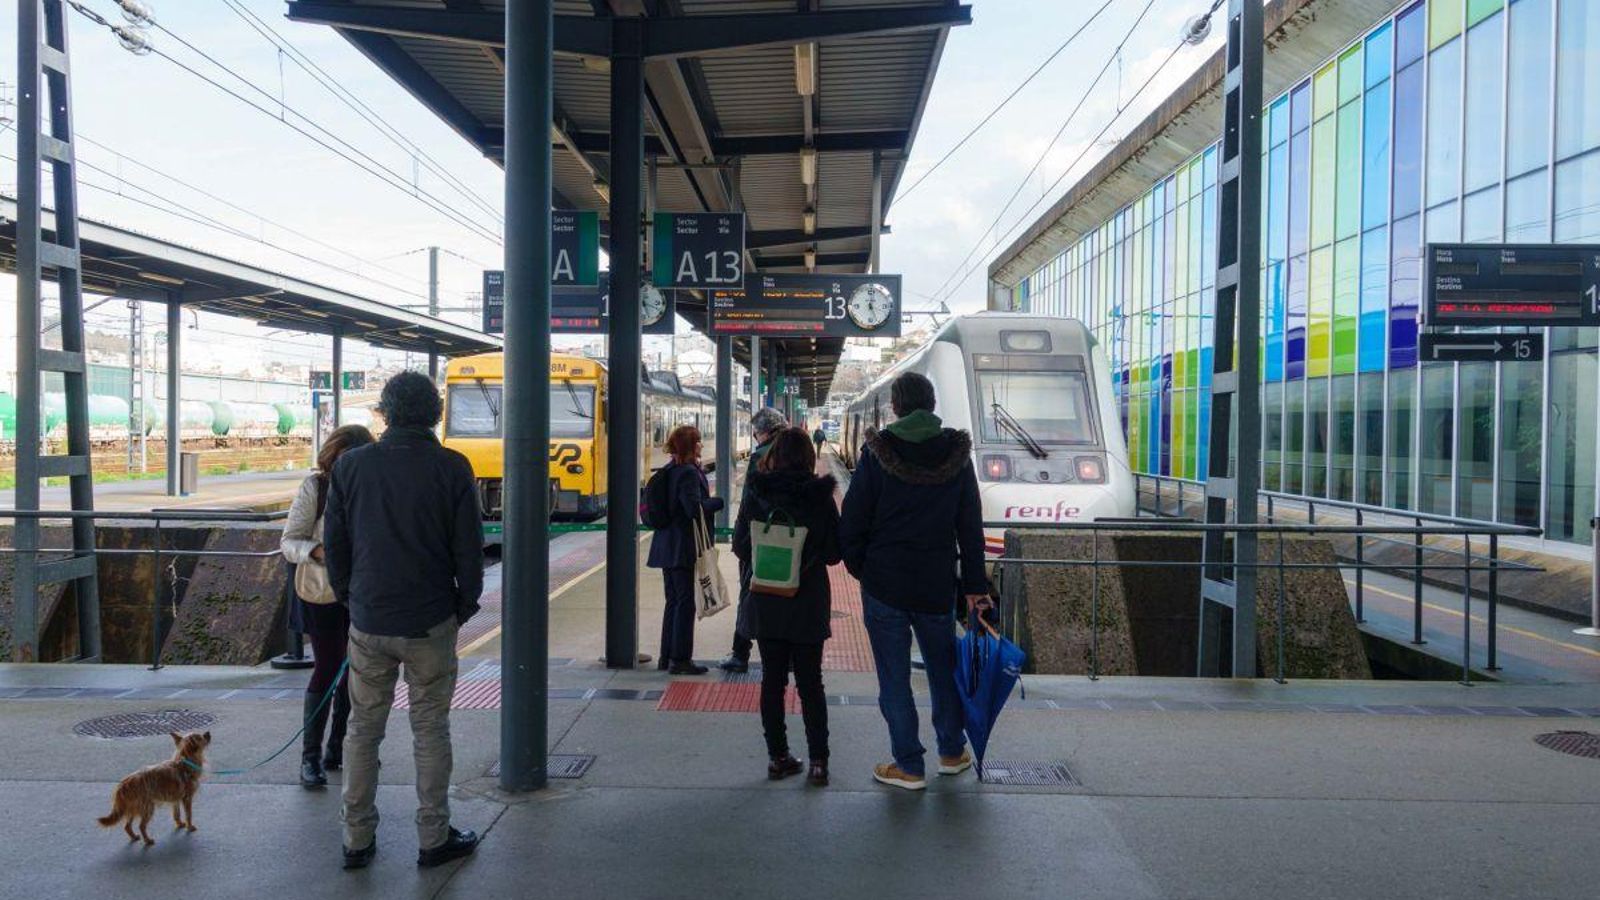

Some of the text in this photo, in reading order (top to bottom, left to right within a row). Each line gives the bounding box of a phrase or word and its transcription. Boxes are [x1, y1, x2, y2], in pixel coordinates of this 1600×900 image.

[676, 218, 698, 226] Sector
[552, 248, 575, 281] A
[676, 251, 741, 283] A 13
[825, 296, 846, 320] 13
[1585, 284, 1600, 314] 1
[1512, 339, 1531, 359] 15
[1004, 500, 1081, 522] renfe
